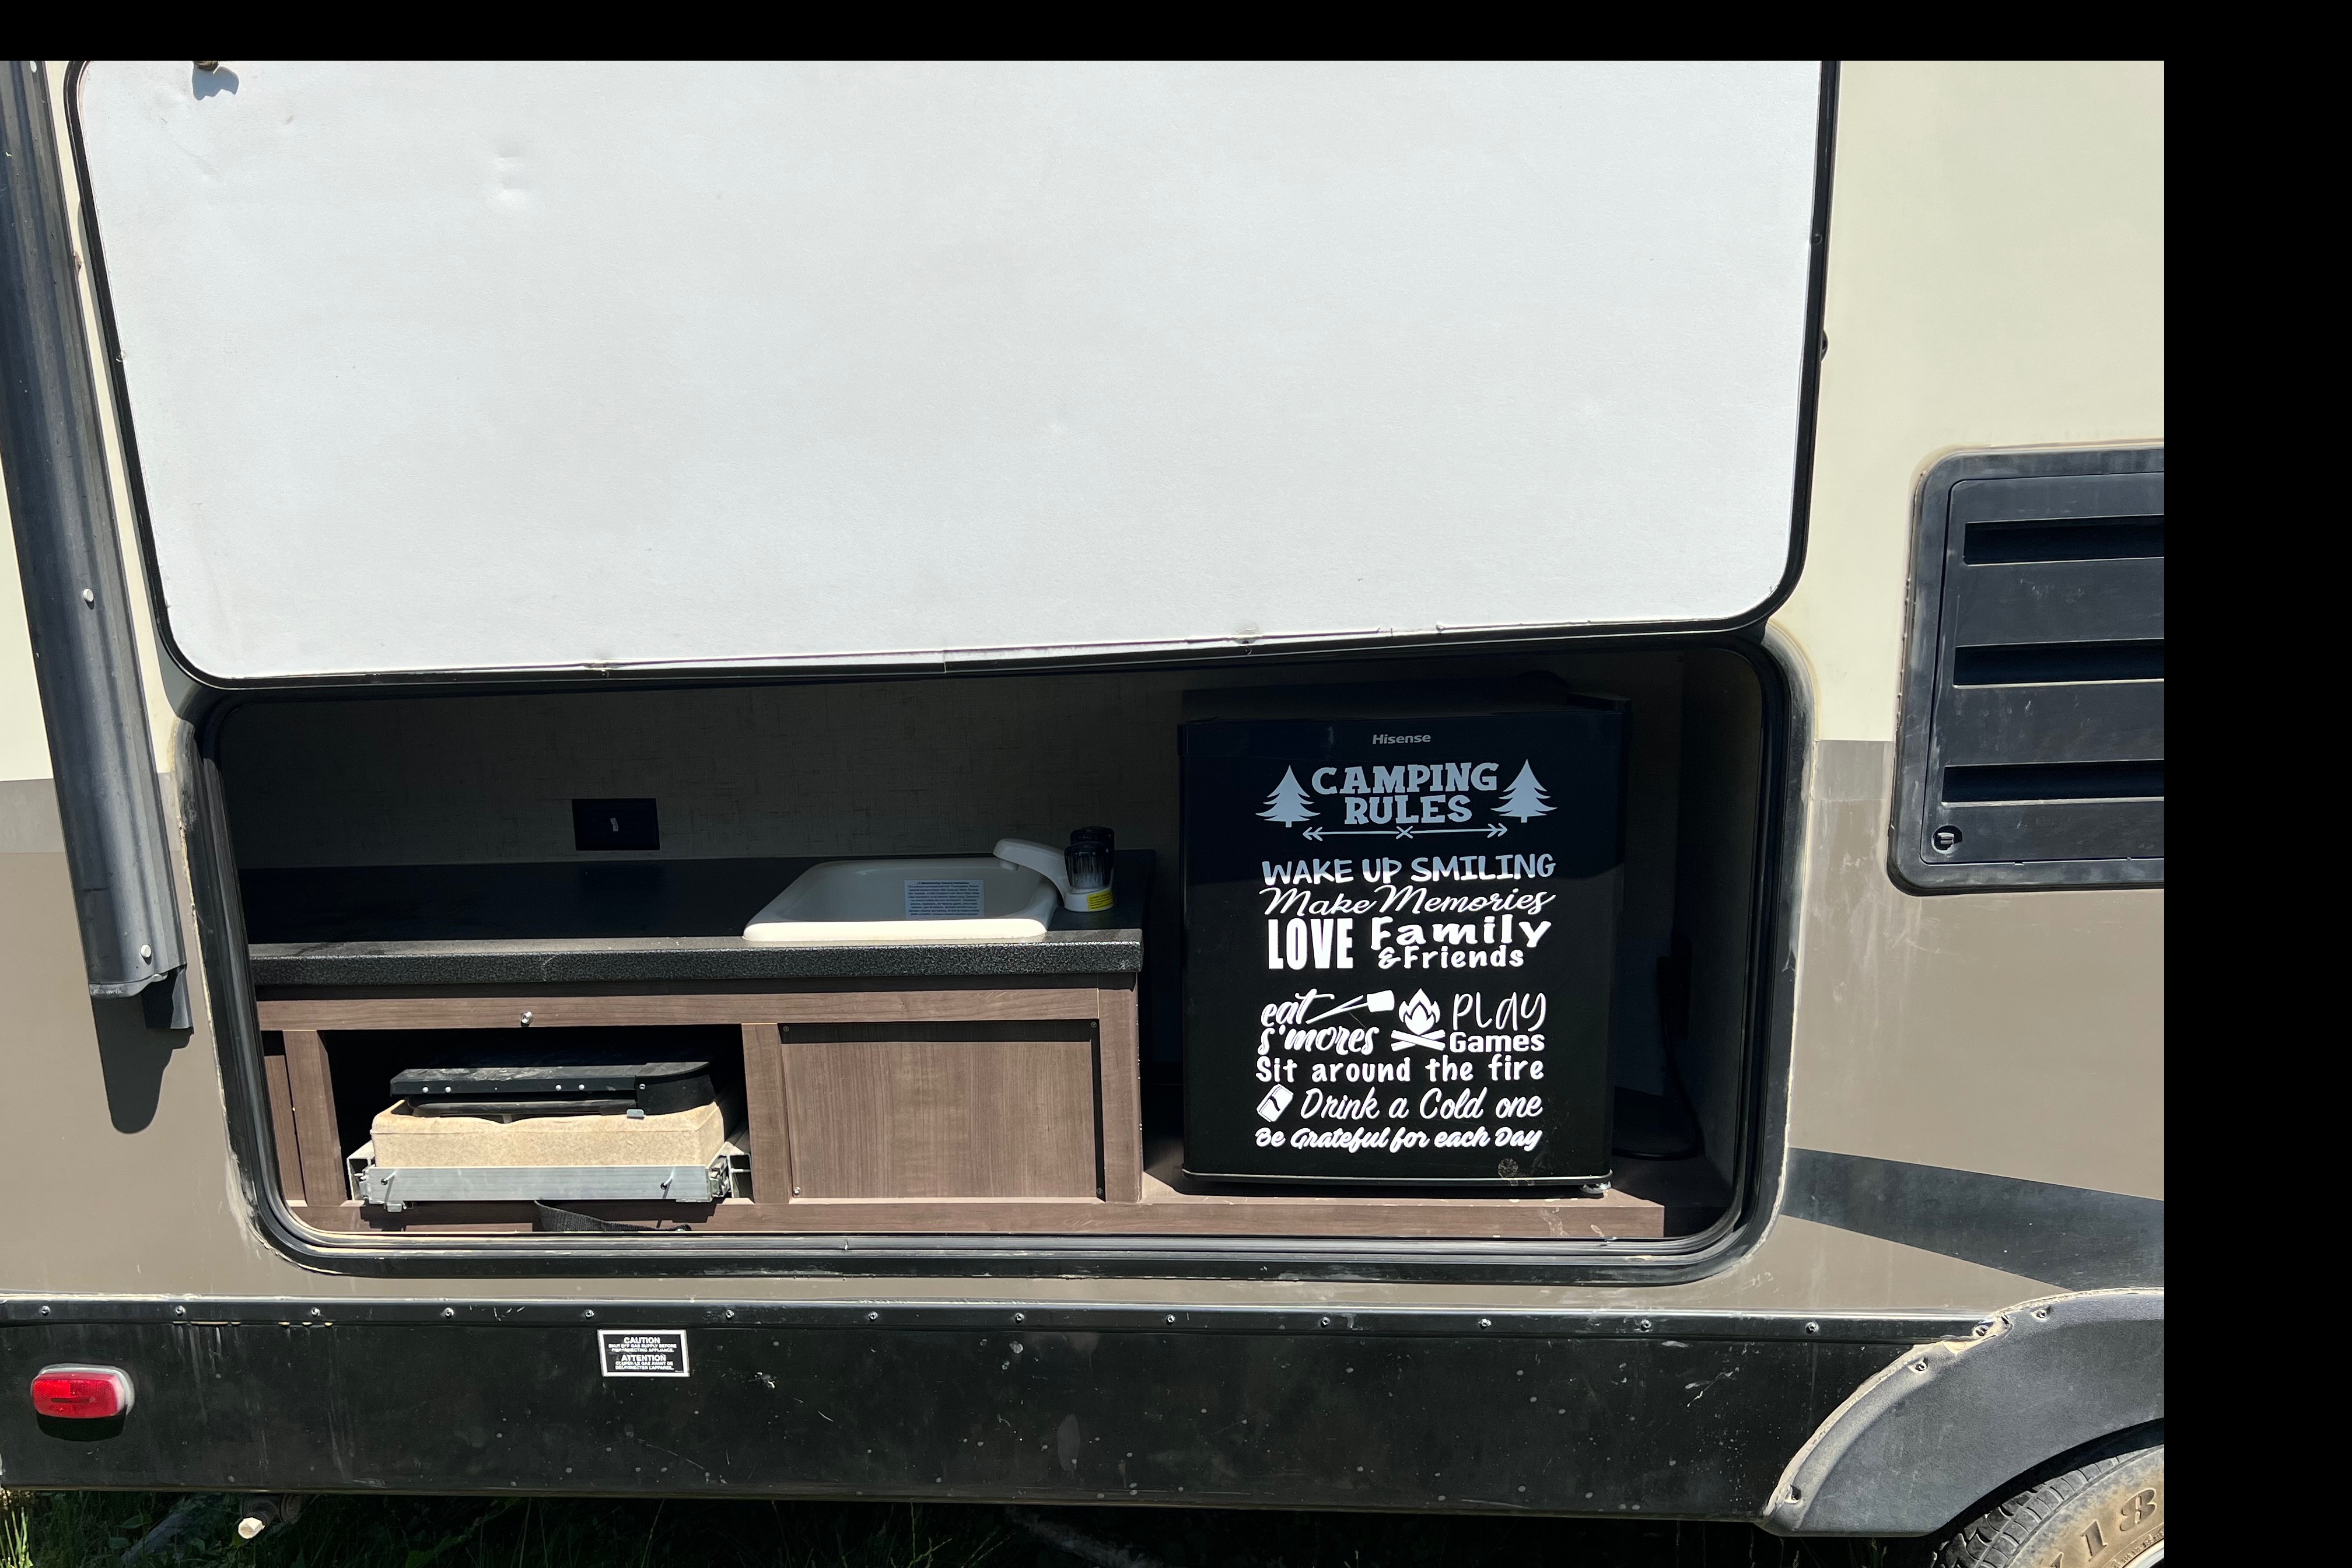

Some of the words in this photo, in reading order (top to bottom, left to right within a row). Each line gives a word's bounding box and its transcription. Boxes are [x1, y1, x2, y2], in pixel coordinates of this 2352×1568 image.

[1373, 734, 1432, 745] Hisense
[1311, 762, 1499, 794] CAMPING
[1344, 794, 1472, 825] RULES
[1262, 859, 1354, 886] WAKE
[1362, 858, 1402, 884] UP
[1410, 853, 1556, 883] SMILING
[1259, 887, 1377, 916] Make
[1374, 884, 1556, 915] Memories
[1268, 918, 1353, 970] LOVE
[1370, 914, 1552, 951] Family
[1261, 988, 1335, 1027] eat
[1257, 1024, 1380, 1055] s'mores
[1450, 1031, 1545, 1053] Games
[1255, 1055, 1297, 1083] Sit
[1311, 1056, 1410, 1083] around
[1424, 1054, 1474, 1082] the
[1488, 1053, 1544, 1081] fire
[1300, 1086, 1380, 1120] Drink
[1388, 1097, 1409, 1119] a
[1419, 1086, 1488, 1119] Cold
[1495, 1095, 1543, 1119] one
[1255, 1127, 1286, 1147] Be
[1290, 1126, 1391, 1153] Grateful
[1389, 1126, 1430, 1153] for
[1434, 1126, 1491, 1148] each
[1494, 1126, 1543, 1152] Day
